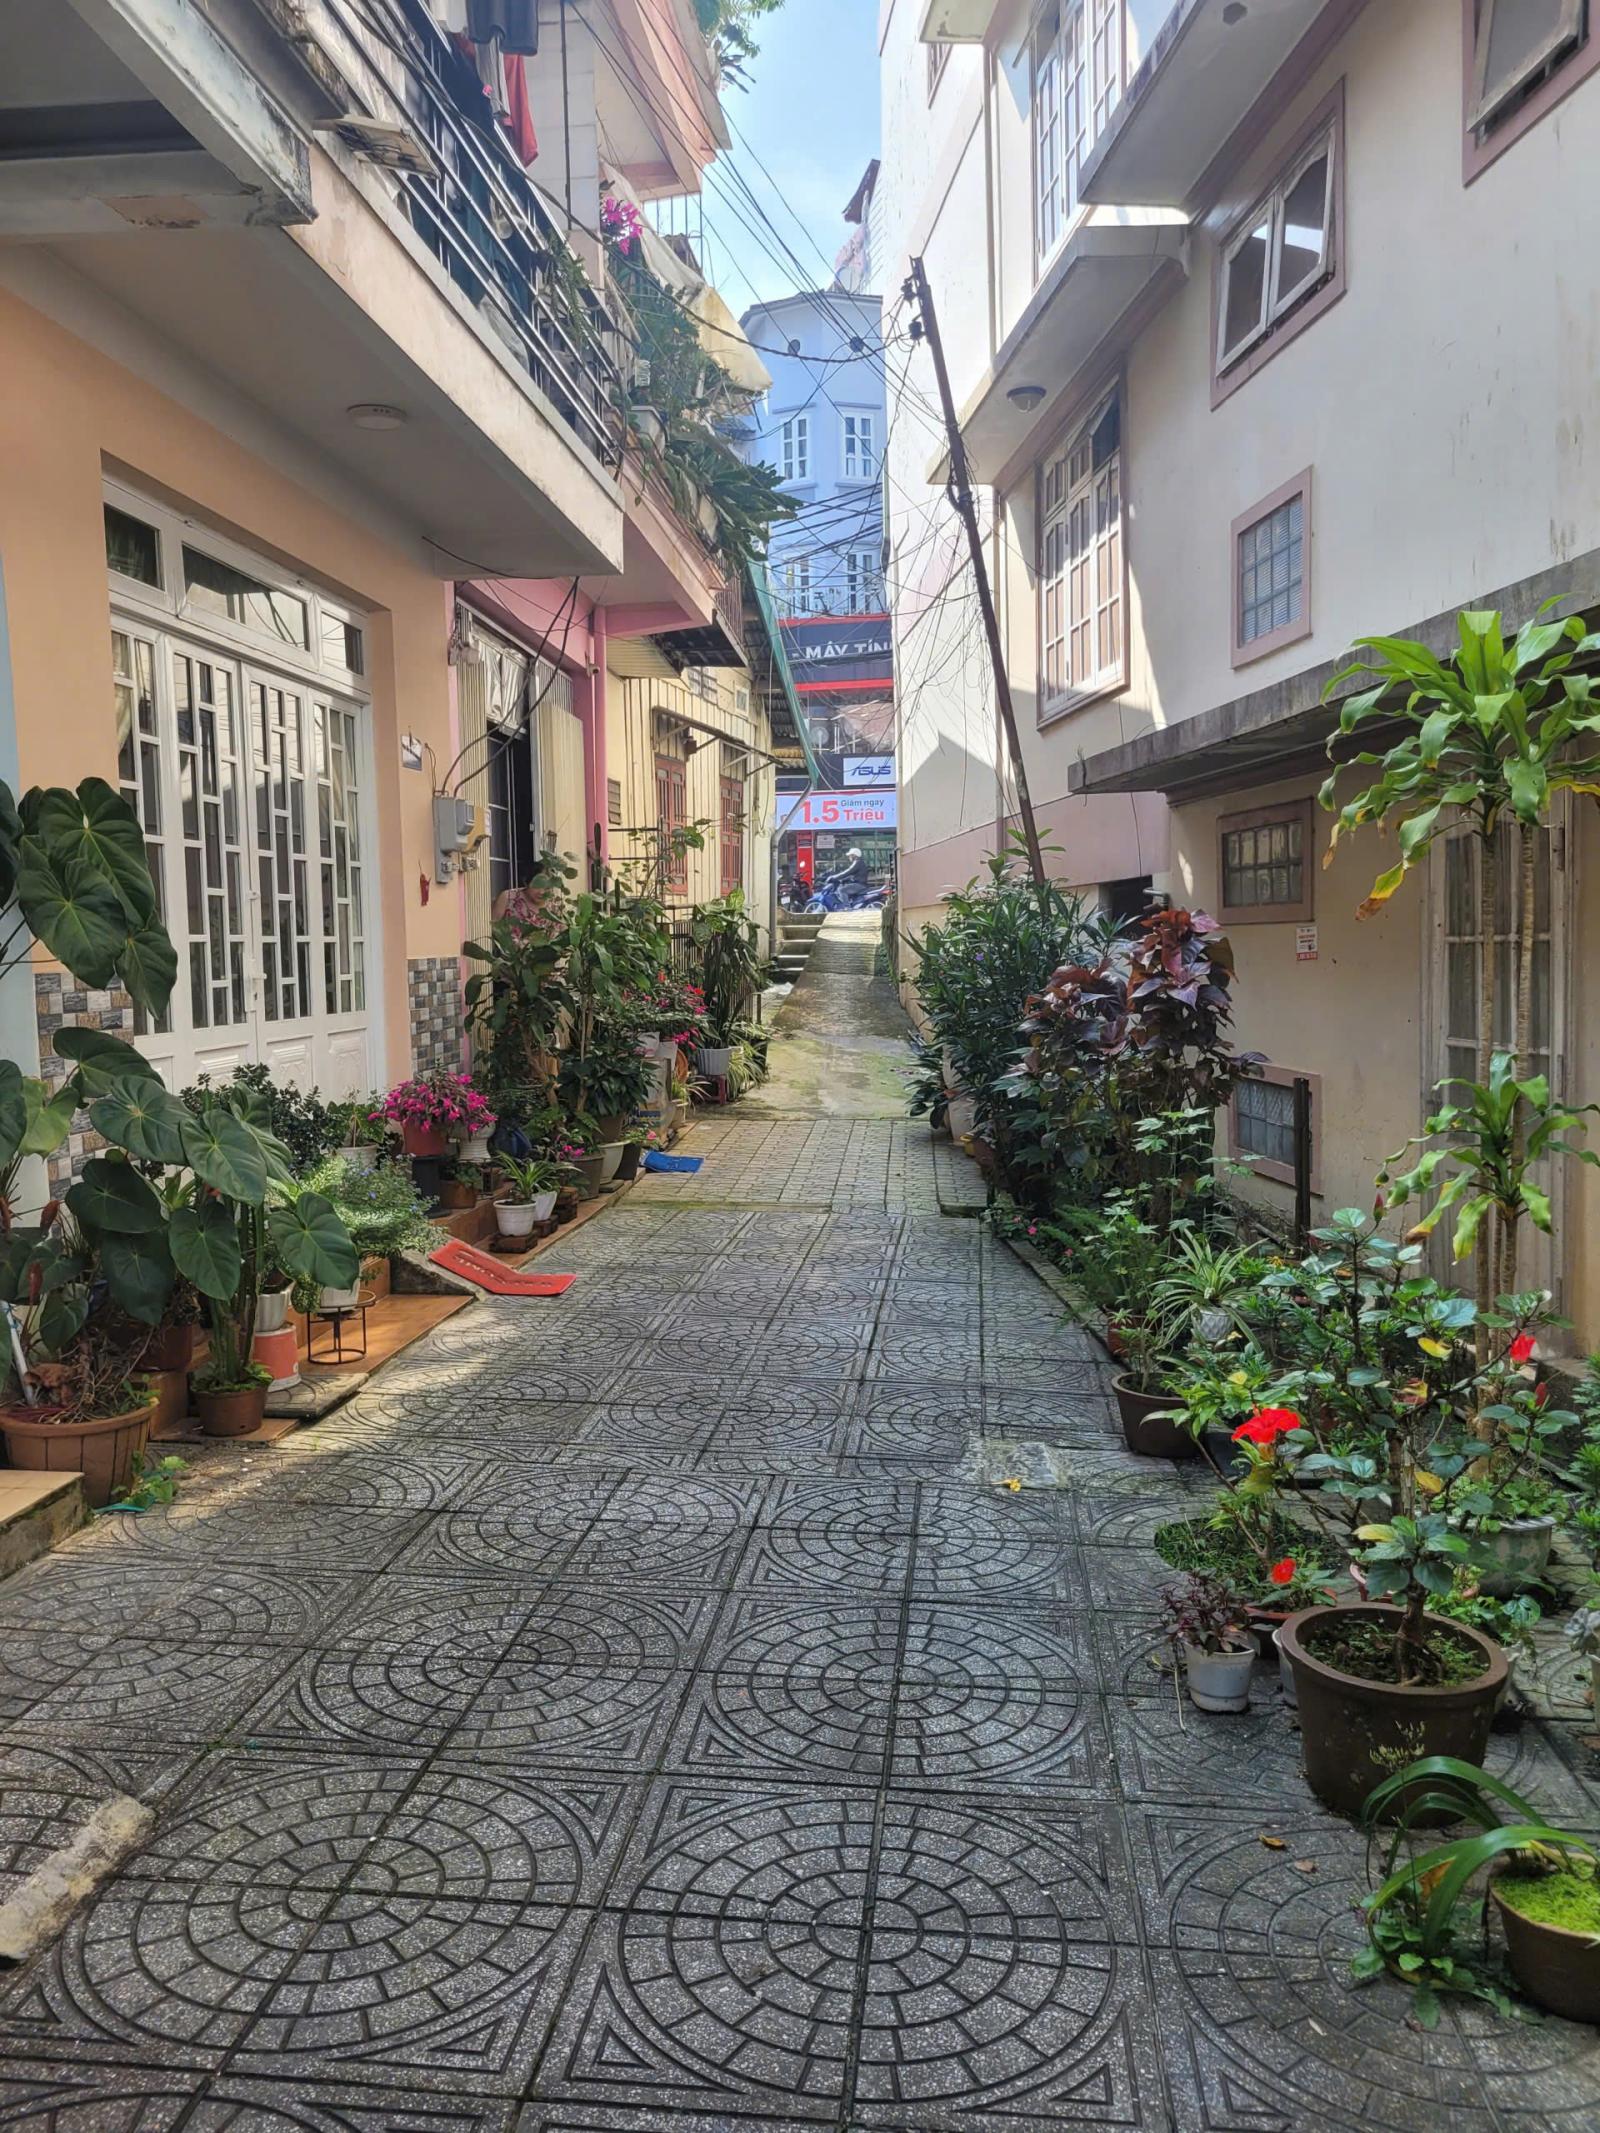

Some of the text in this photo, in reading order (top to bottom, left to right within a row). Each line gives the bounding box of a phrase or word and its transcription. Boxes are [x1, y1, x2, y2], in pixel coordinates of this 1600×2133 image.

[854, 639, 893, 655] TÍN
[851, 765, 892, 776] ASUS
[800, 799, 840, 824] 1.5
[864, 799, 884, 808] ngay
[843, 808, 884, 824] Triệu
